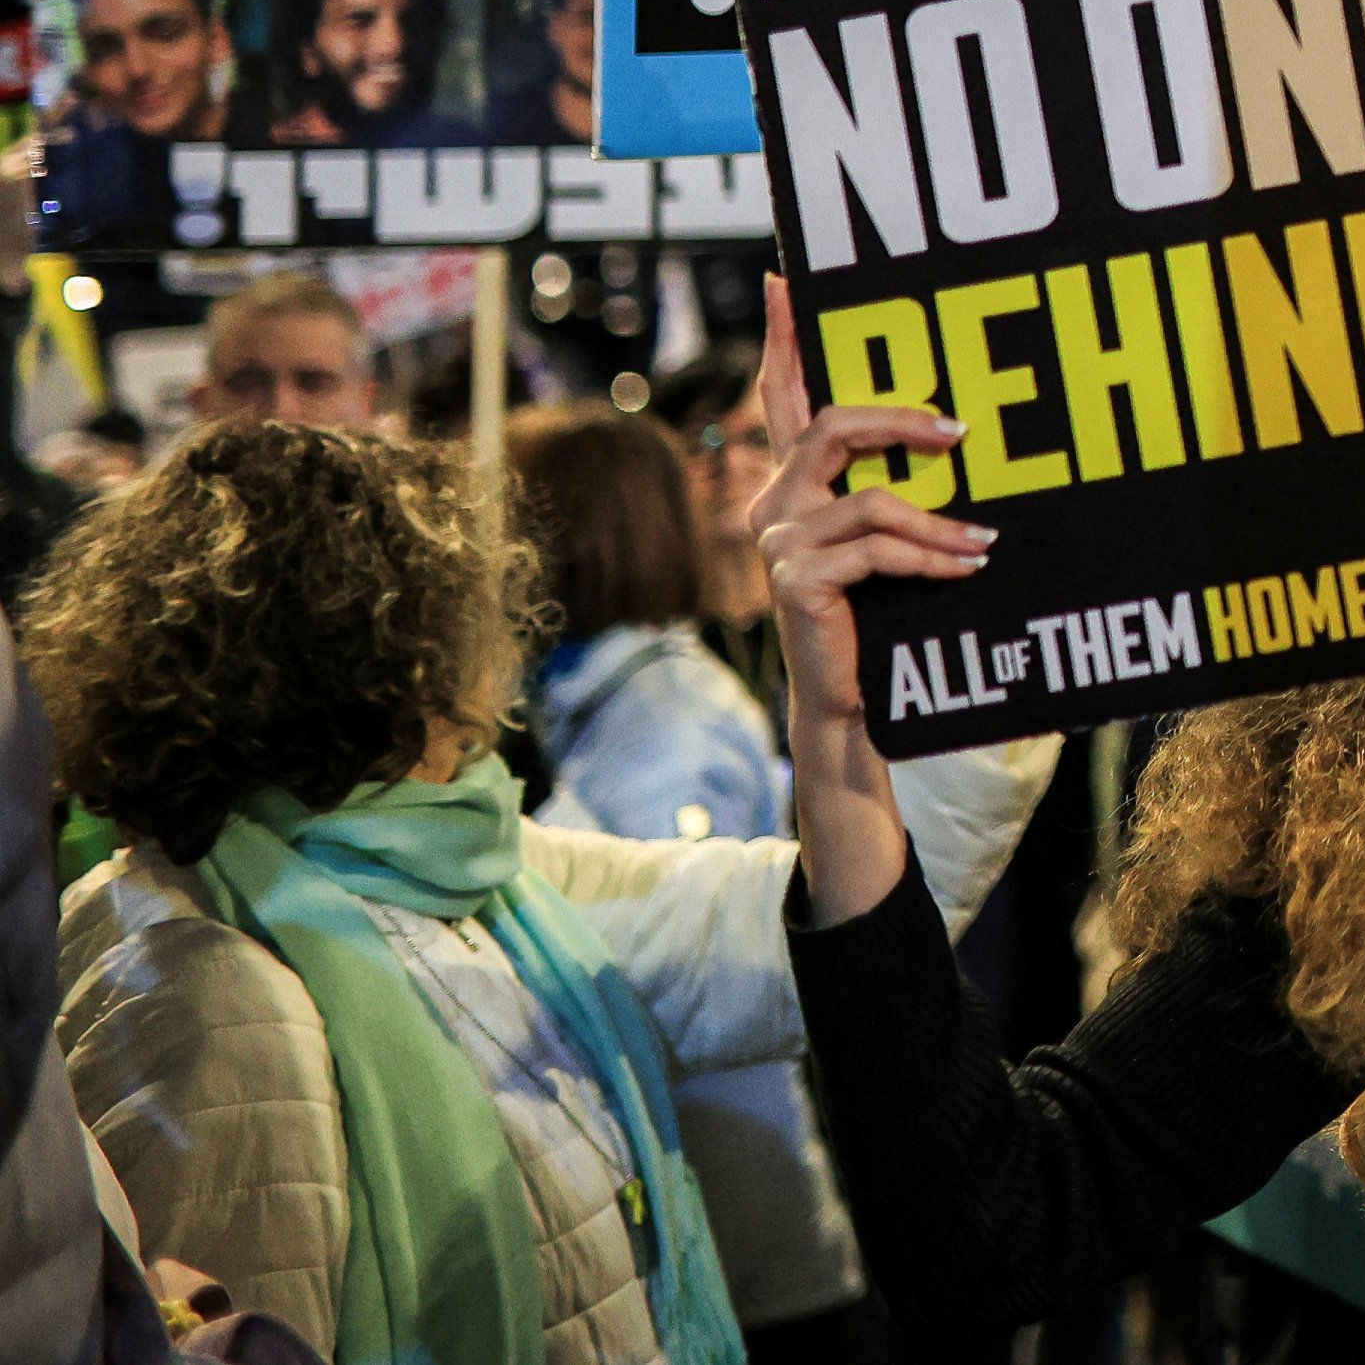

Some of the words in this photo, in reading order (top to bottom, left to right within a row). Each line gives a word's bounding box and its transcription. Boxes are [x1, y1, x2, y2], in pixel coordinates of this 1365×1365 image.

[168, 142, 777, 247] עכשיו!
[889, 630, 1010, 721] ALL
[994, 641, 1031, 684] OF
[1027, 591, 1200, 694] THEM
